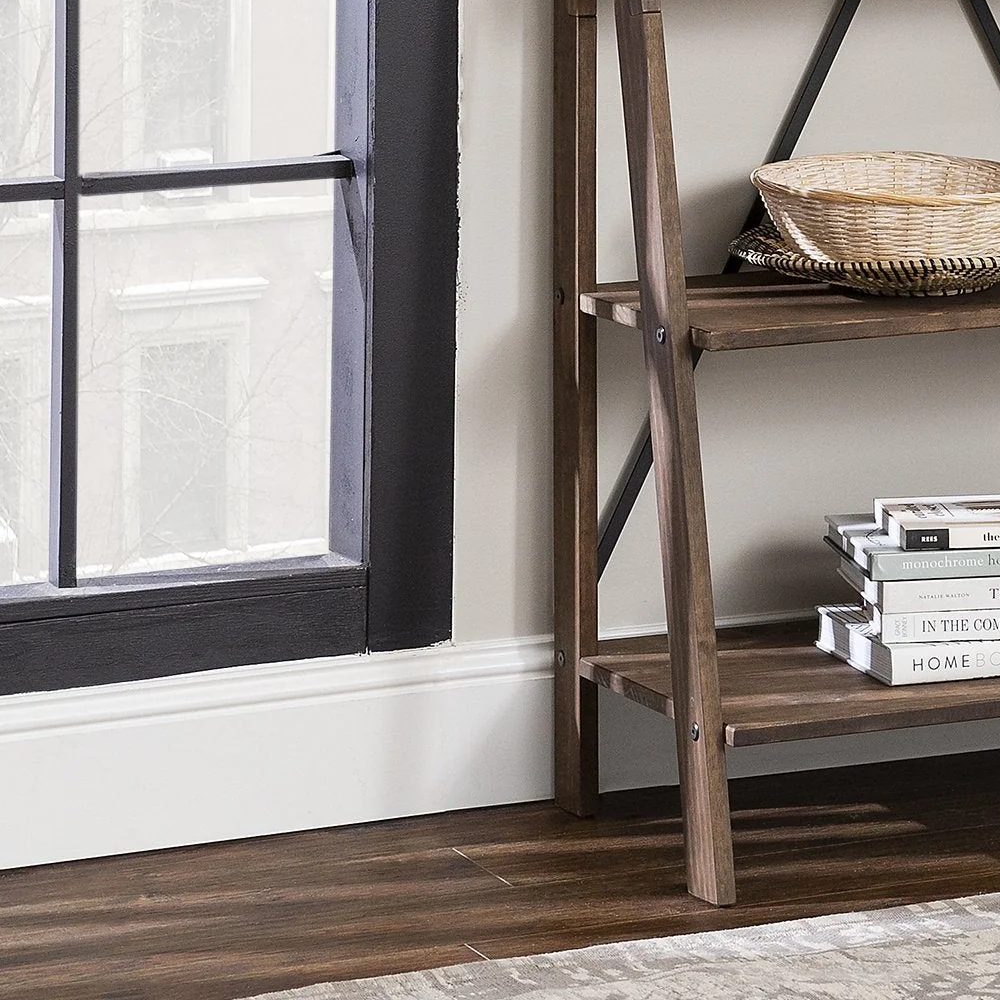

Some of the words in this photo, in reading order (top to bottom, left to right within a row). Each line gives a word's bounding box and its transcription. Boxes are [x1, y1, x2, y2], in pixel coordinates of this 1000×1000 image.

[983, 532, 1000, 542] the
[902, 556, 984, 570] monochrome
[922, 620, 937, 632] IN
[940, 619, 969, 632] THE
